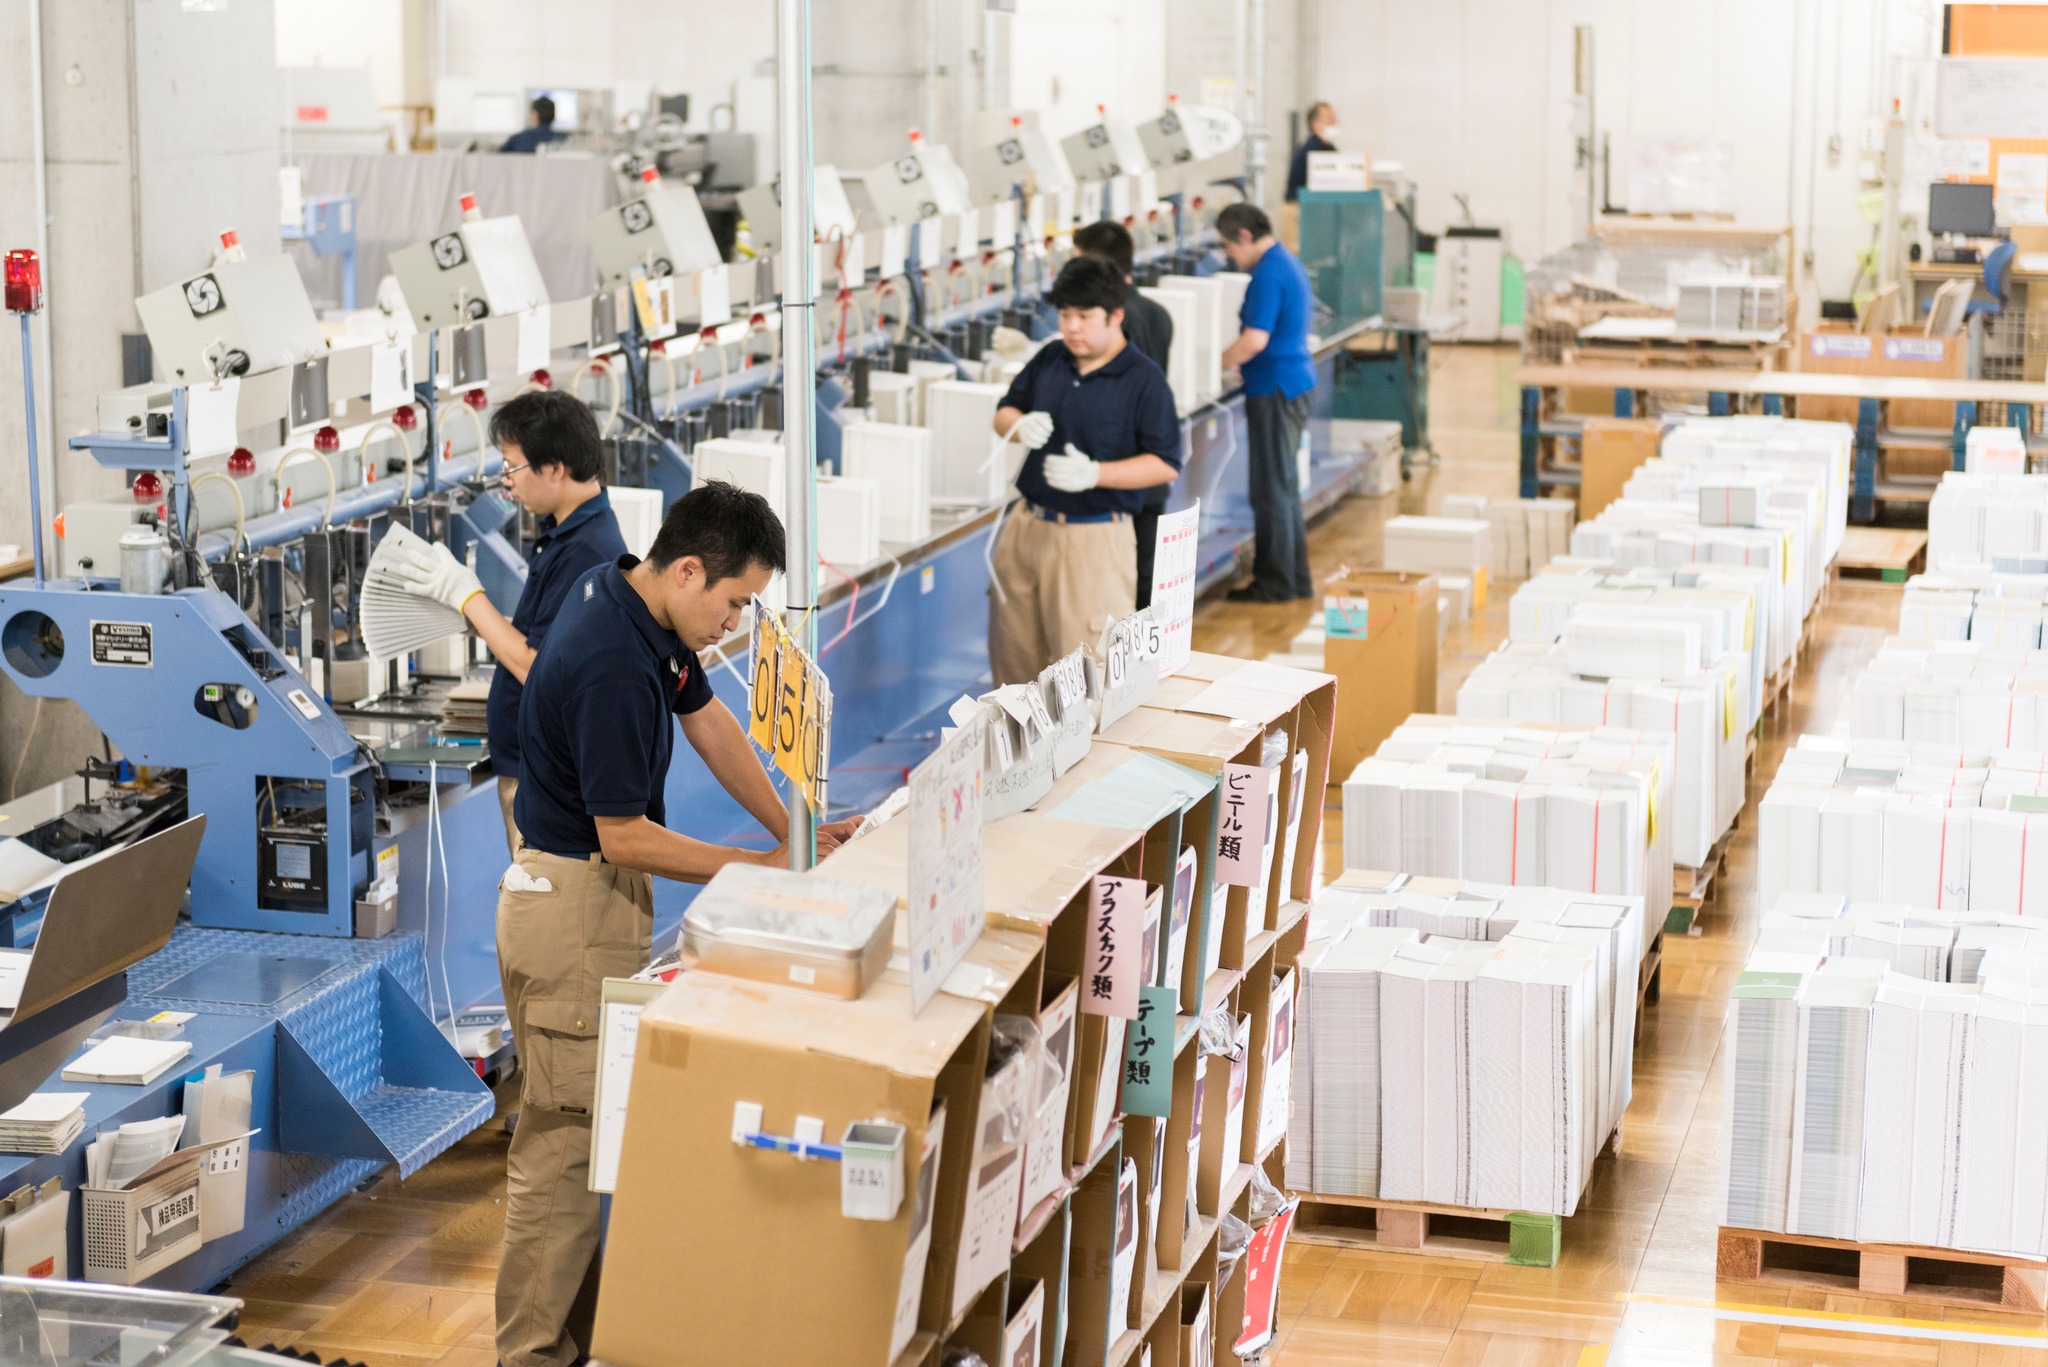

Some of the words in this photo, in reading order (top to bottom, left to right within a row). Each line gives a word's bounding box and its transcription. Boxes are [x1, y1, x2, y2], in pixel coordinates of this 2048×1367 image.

[1218, 773, 1251, 861] ビニール類
[1091, 881, 1122, 1000] プラスチック類
[1126, 999, 1155, 1085] テープ類
